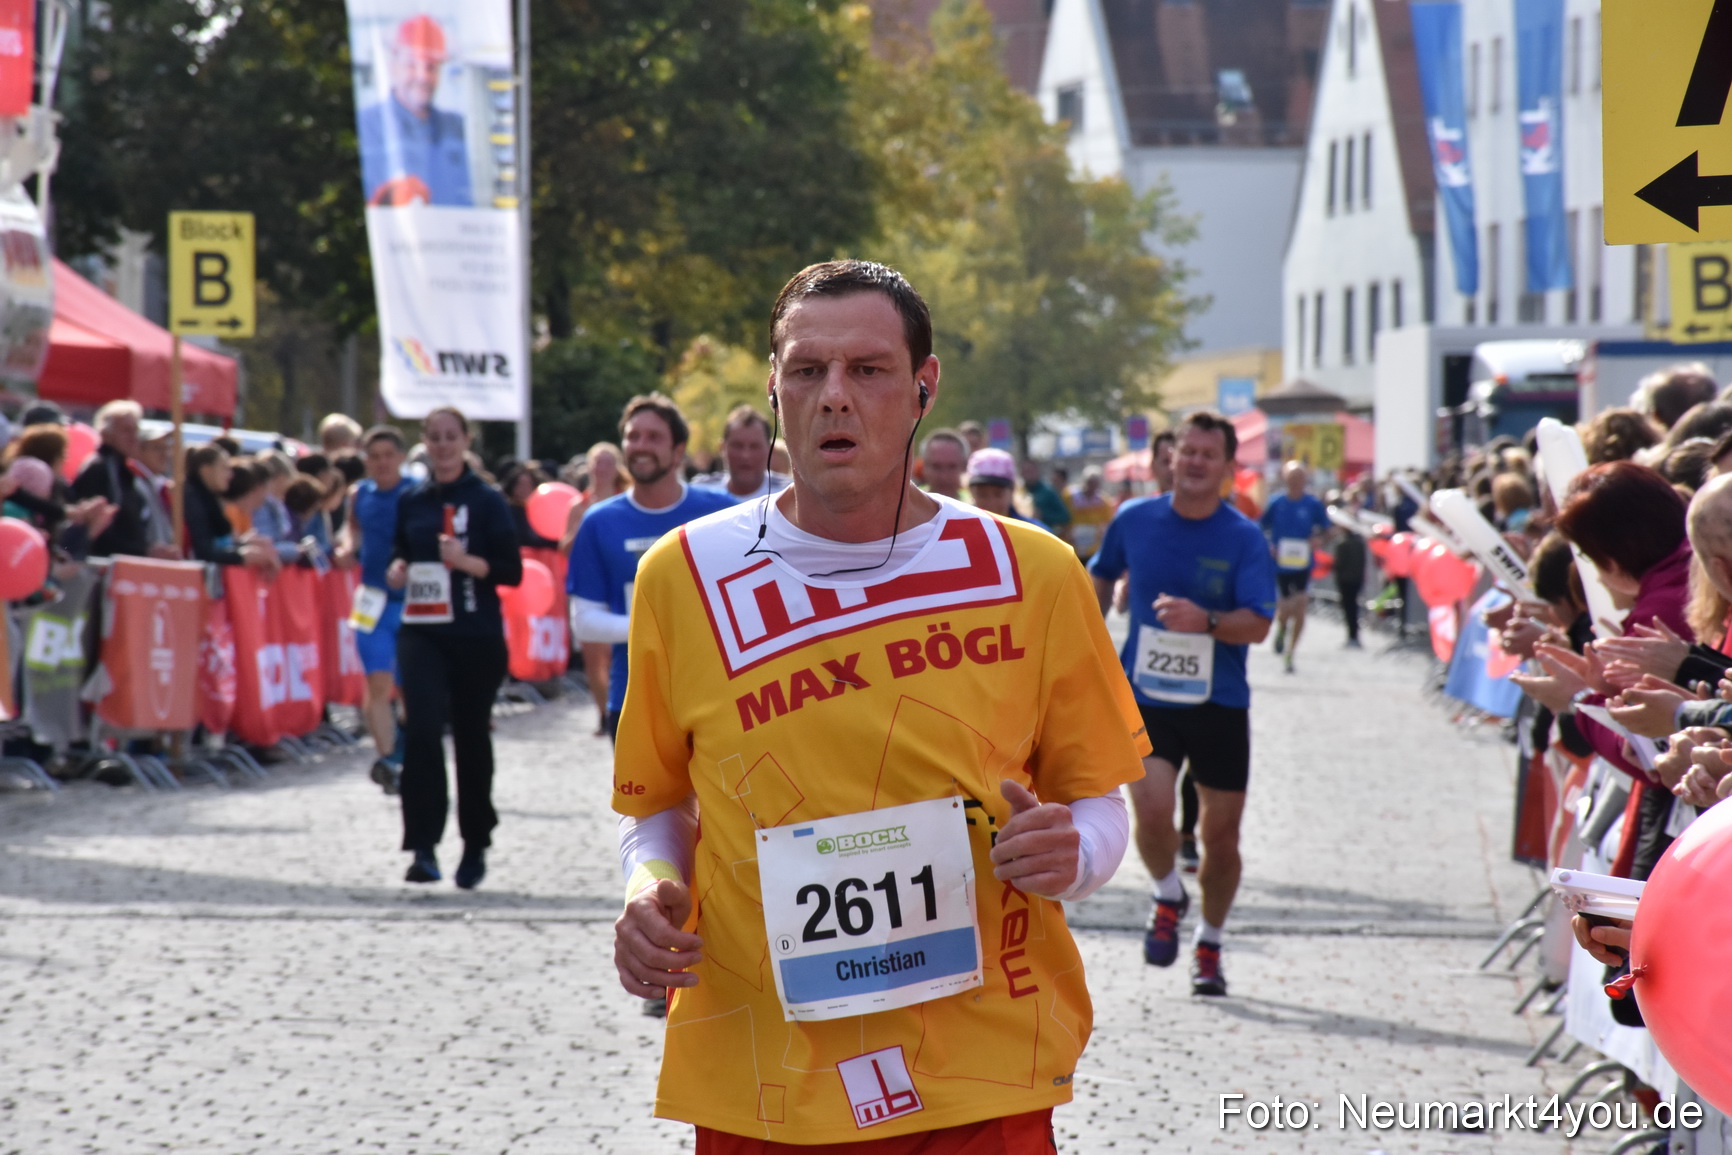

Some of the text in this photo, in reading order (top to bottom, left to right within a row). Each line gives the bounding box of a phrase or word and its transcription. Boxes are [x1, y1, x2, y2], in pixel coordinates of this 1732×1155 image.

[181, 217, 243, 241] Block
[193, 252, 232, 307] B
[1693, 255, 1732, 313] B
[735, 621, 1026, 733] MAX BÖGL
[1147, 651, 1199, 677] 2235
[836, 825, 910, 852] BOCK
[839, 849, 861, 858] inspired
[870, 845, 886, 853] smart
[887, 841, 912, 850] concepts
[796, 864, 938, 943] 2611
[781, 939, 790, 950] D
[836, 950, 926, 981] Christian
